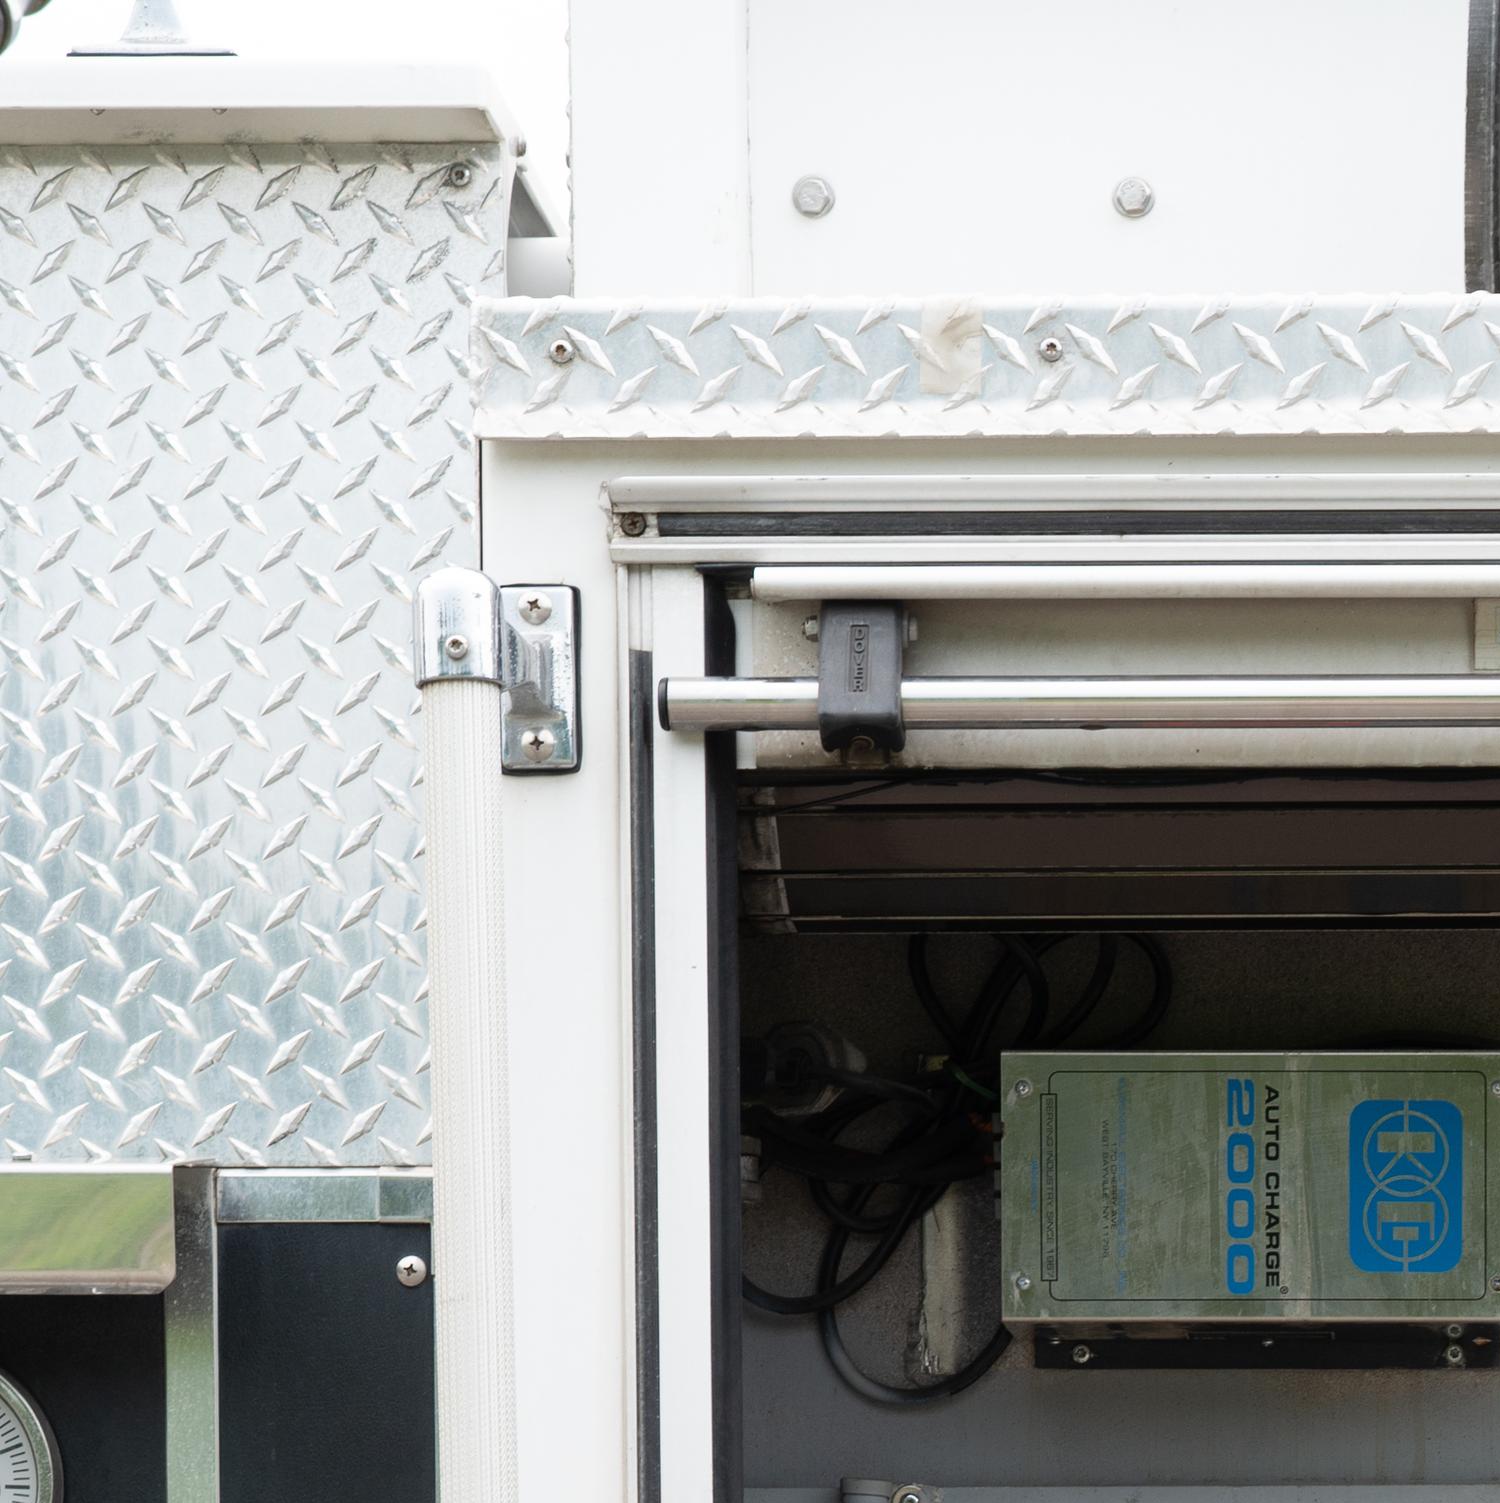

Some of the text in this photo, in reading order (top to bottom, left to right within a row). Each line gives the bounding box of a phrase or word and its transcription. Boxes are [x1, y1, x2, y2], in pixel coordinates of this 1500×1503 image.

[1046, 1099, 1054, 1146] SERVING
[1046, 1150, 1054, 1206] INDUSTRY
[1227, 1079, 1255, 1295] 2000
[1265, 1085, 1279, 1287] AUTO CHARGE
[1046, 1211, 1054, 1243] SINCE
